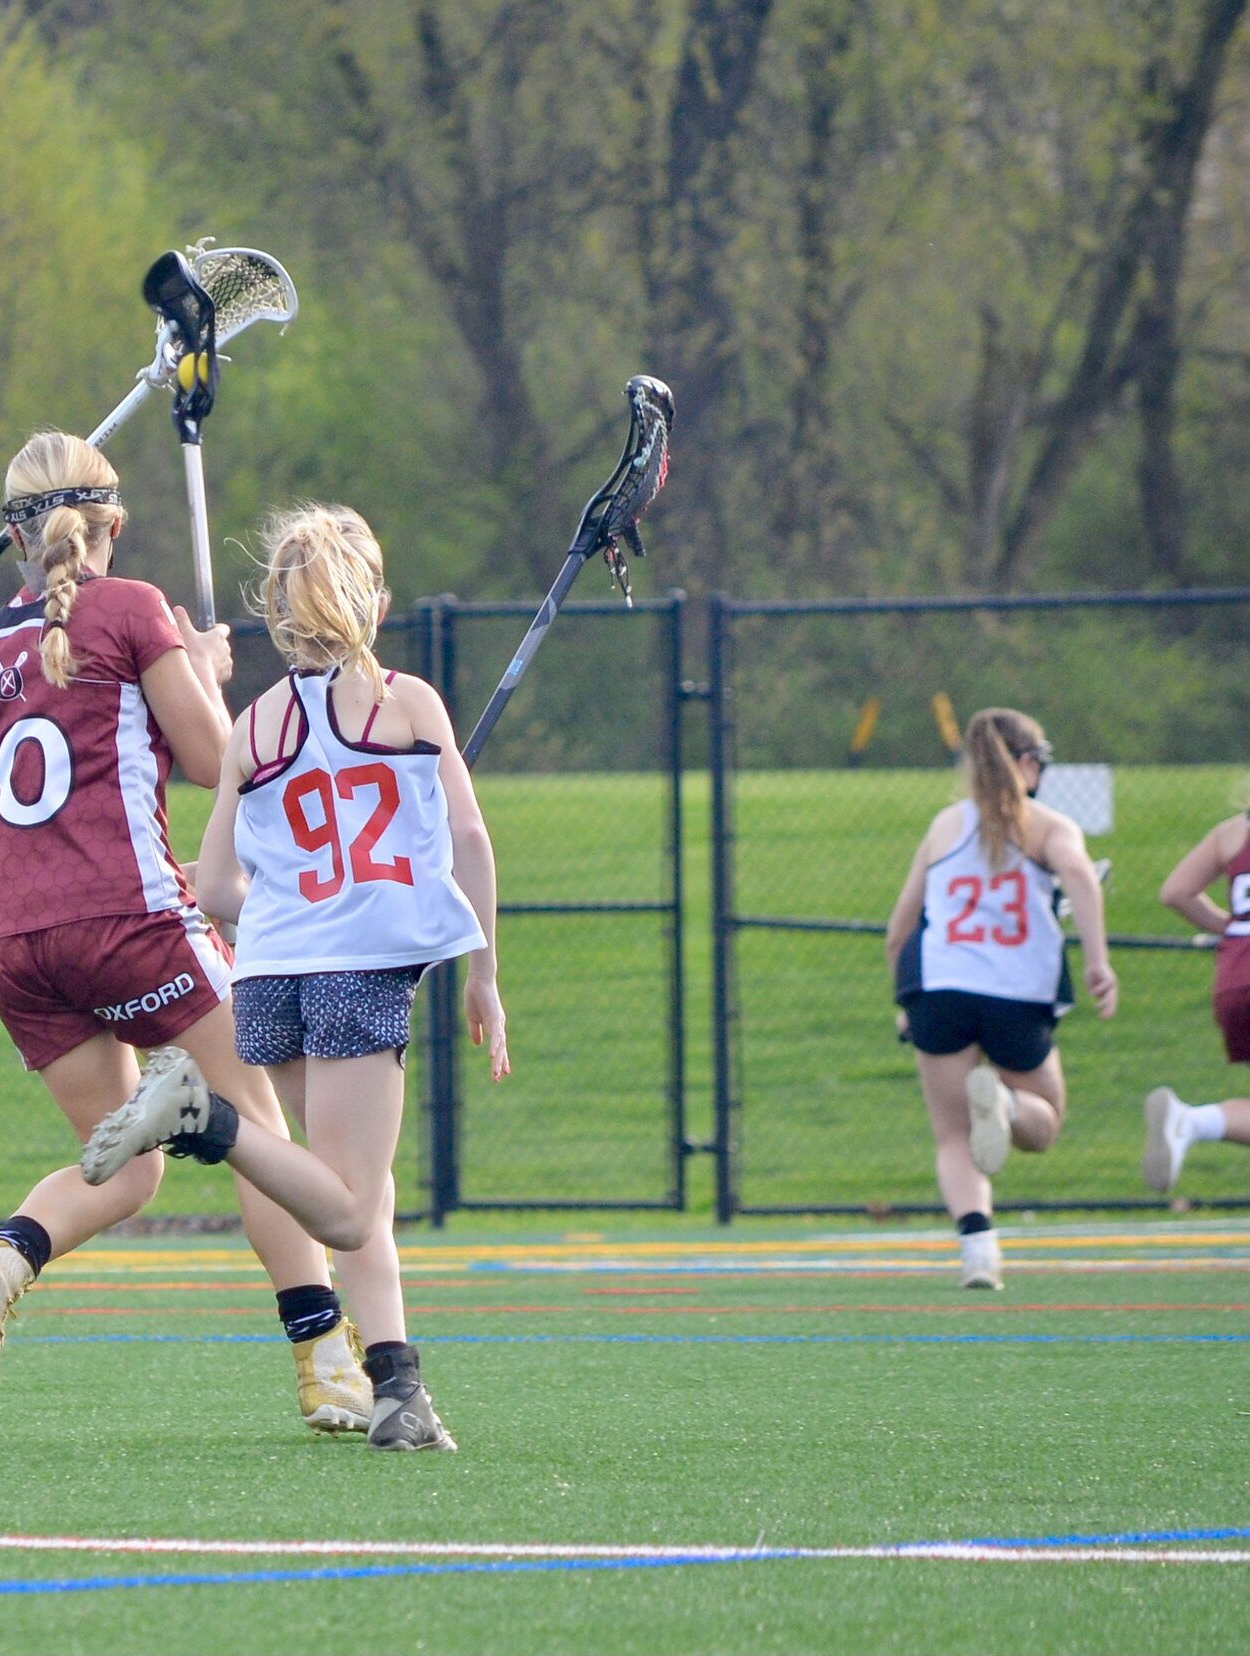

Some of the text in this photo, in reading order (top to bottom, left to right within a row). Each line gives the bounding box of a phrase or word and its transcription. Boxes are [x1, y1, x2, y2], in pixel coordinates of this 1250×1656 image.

[282, 761, 415, 904] 92
[946, 869, 1029, 947] 23
[93, 972, 196, 1022] OXFORD
